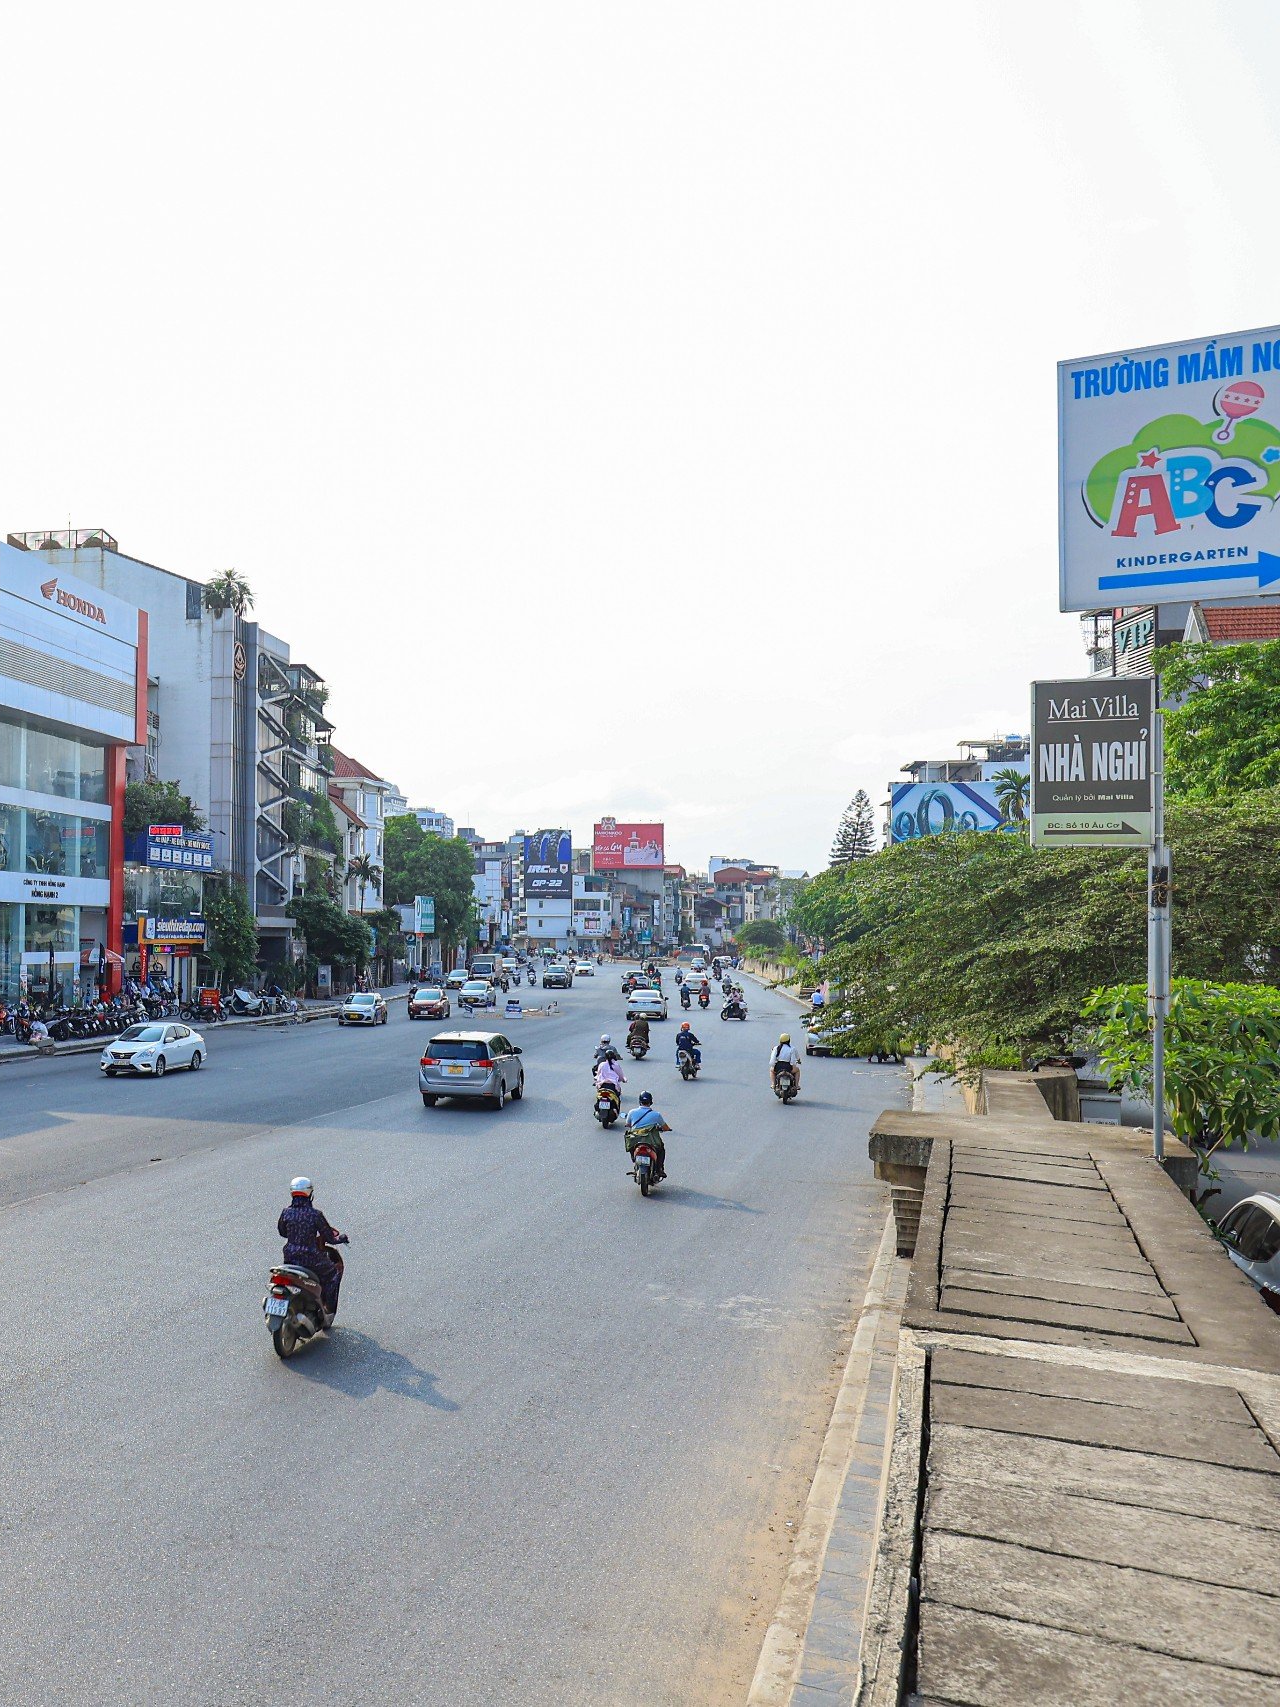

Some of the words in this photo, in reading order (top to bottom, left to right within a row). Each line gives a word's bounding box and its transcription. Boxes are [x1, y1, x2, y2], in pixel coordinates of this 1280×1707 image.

[1071, 356, 1169, 400] TRƯỜNG
[1177, 340, 1243, 385] MẦM
[1111, 455, 1262, 538] ABC
[1116, 546, 1249, 569] KINDERGARTEN
[56, 588, 107, 624] HONDA
[1114, 619, 1152, 654] VIP
[1048, 698, 1088, 720] Mai
[1091, 694, 1140, 719] Villa
[1039, 734, 1086, 783] NHÀ
[1092, 727, 1148, 782] NGHỈ
[1052, 794, 1074, 802] Quản
[1075, 794, 1082, 803] lý
[1084, 793, 1096, 801] bởi
